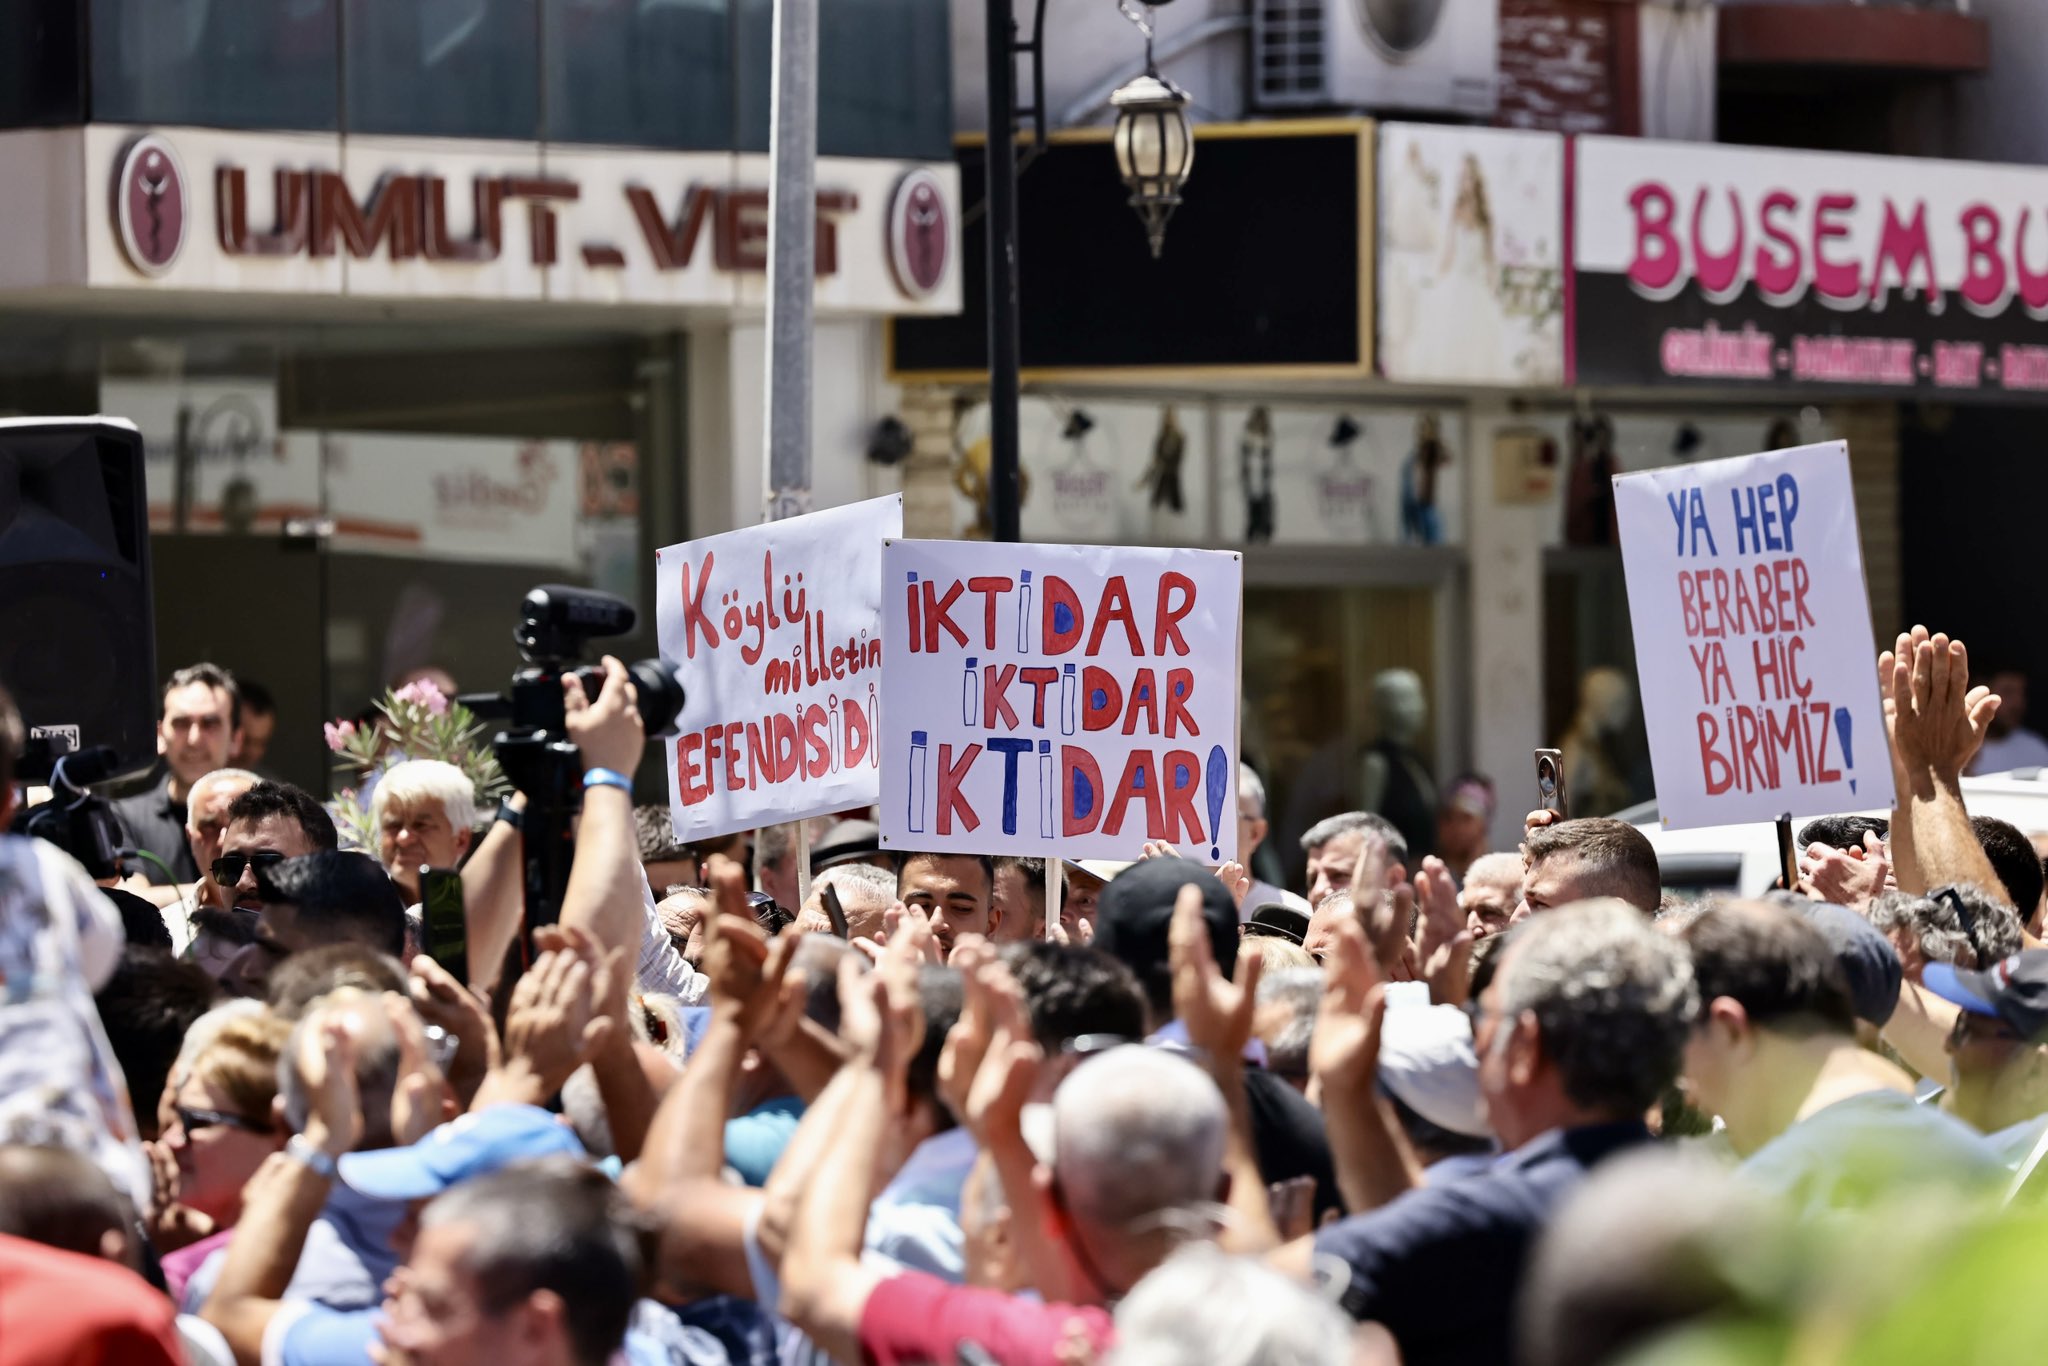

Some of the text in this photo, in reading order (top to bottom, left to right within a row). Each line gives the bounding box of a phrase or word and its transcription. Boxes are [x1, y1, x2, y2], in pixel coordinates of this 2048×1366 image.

[1627, 180, 1944, 308] BUSEM
[1667, 473, 1799, 557] YA HEP
[682, 550, 805, 665] Köylü
[907, 569, 1196, 656] İKTİDAR
[1678, 558, 1815, 638] BERABER
[764, 609, 881, 695] milletin
[1690, 634, 1813, 709] YA HİÇ
[963, 657, 1200, 739] İKTİDAR
[1697, 702, 1857, 797] BİRİMİZ!
[908, 731, 1228, 861] İKTİDAR!
